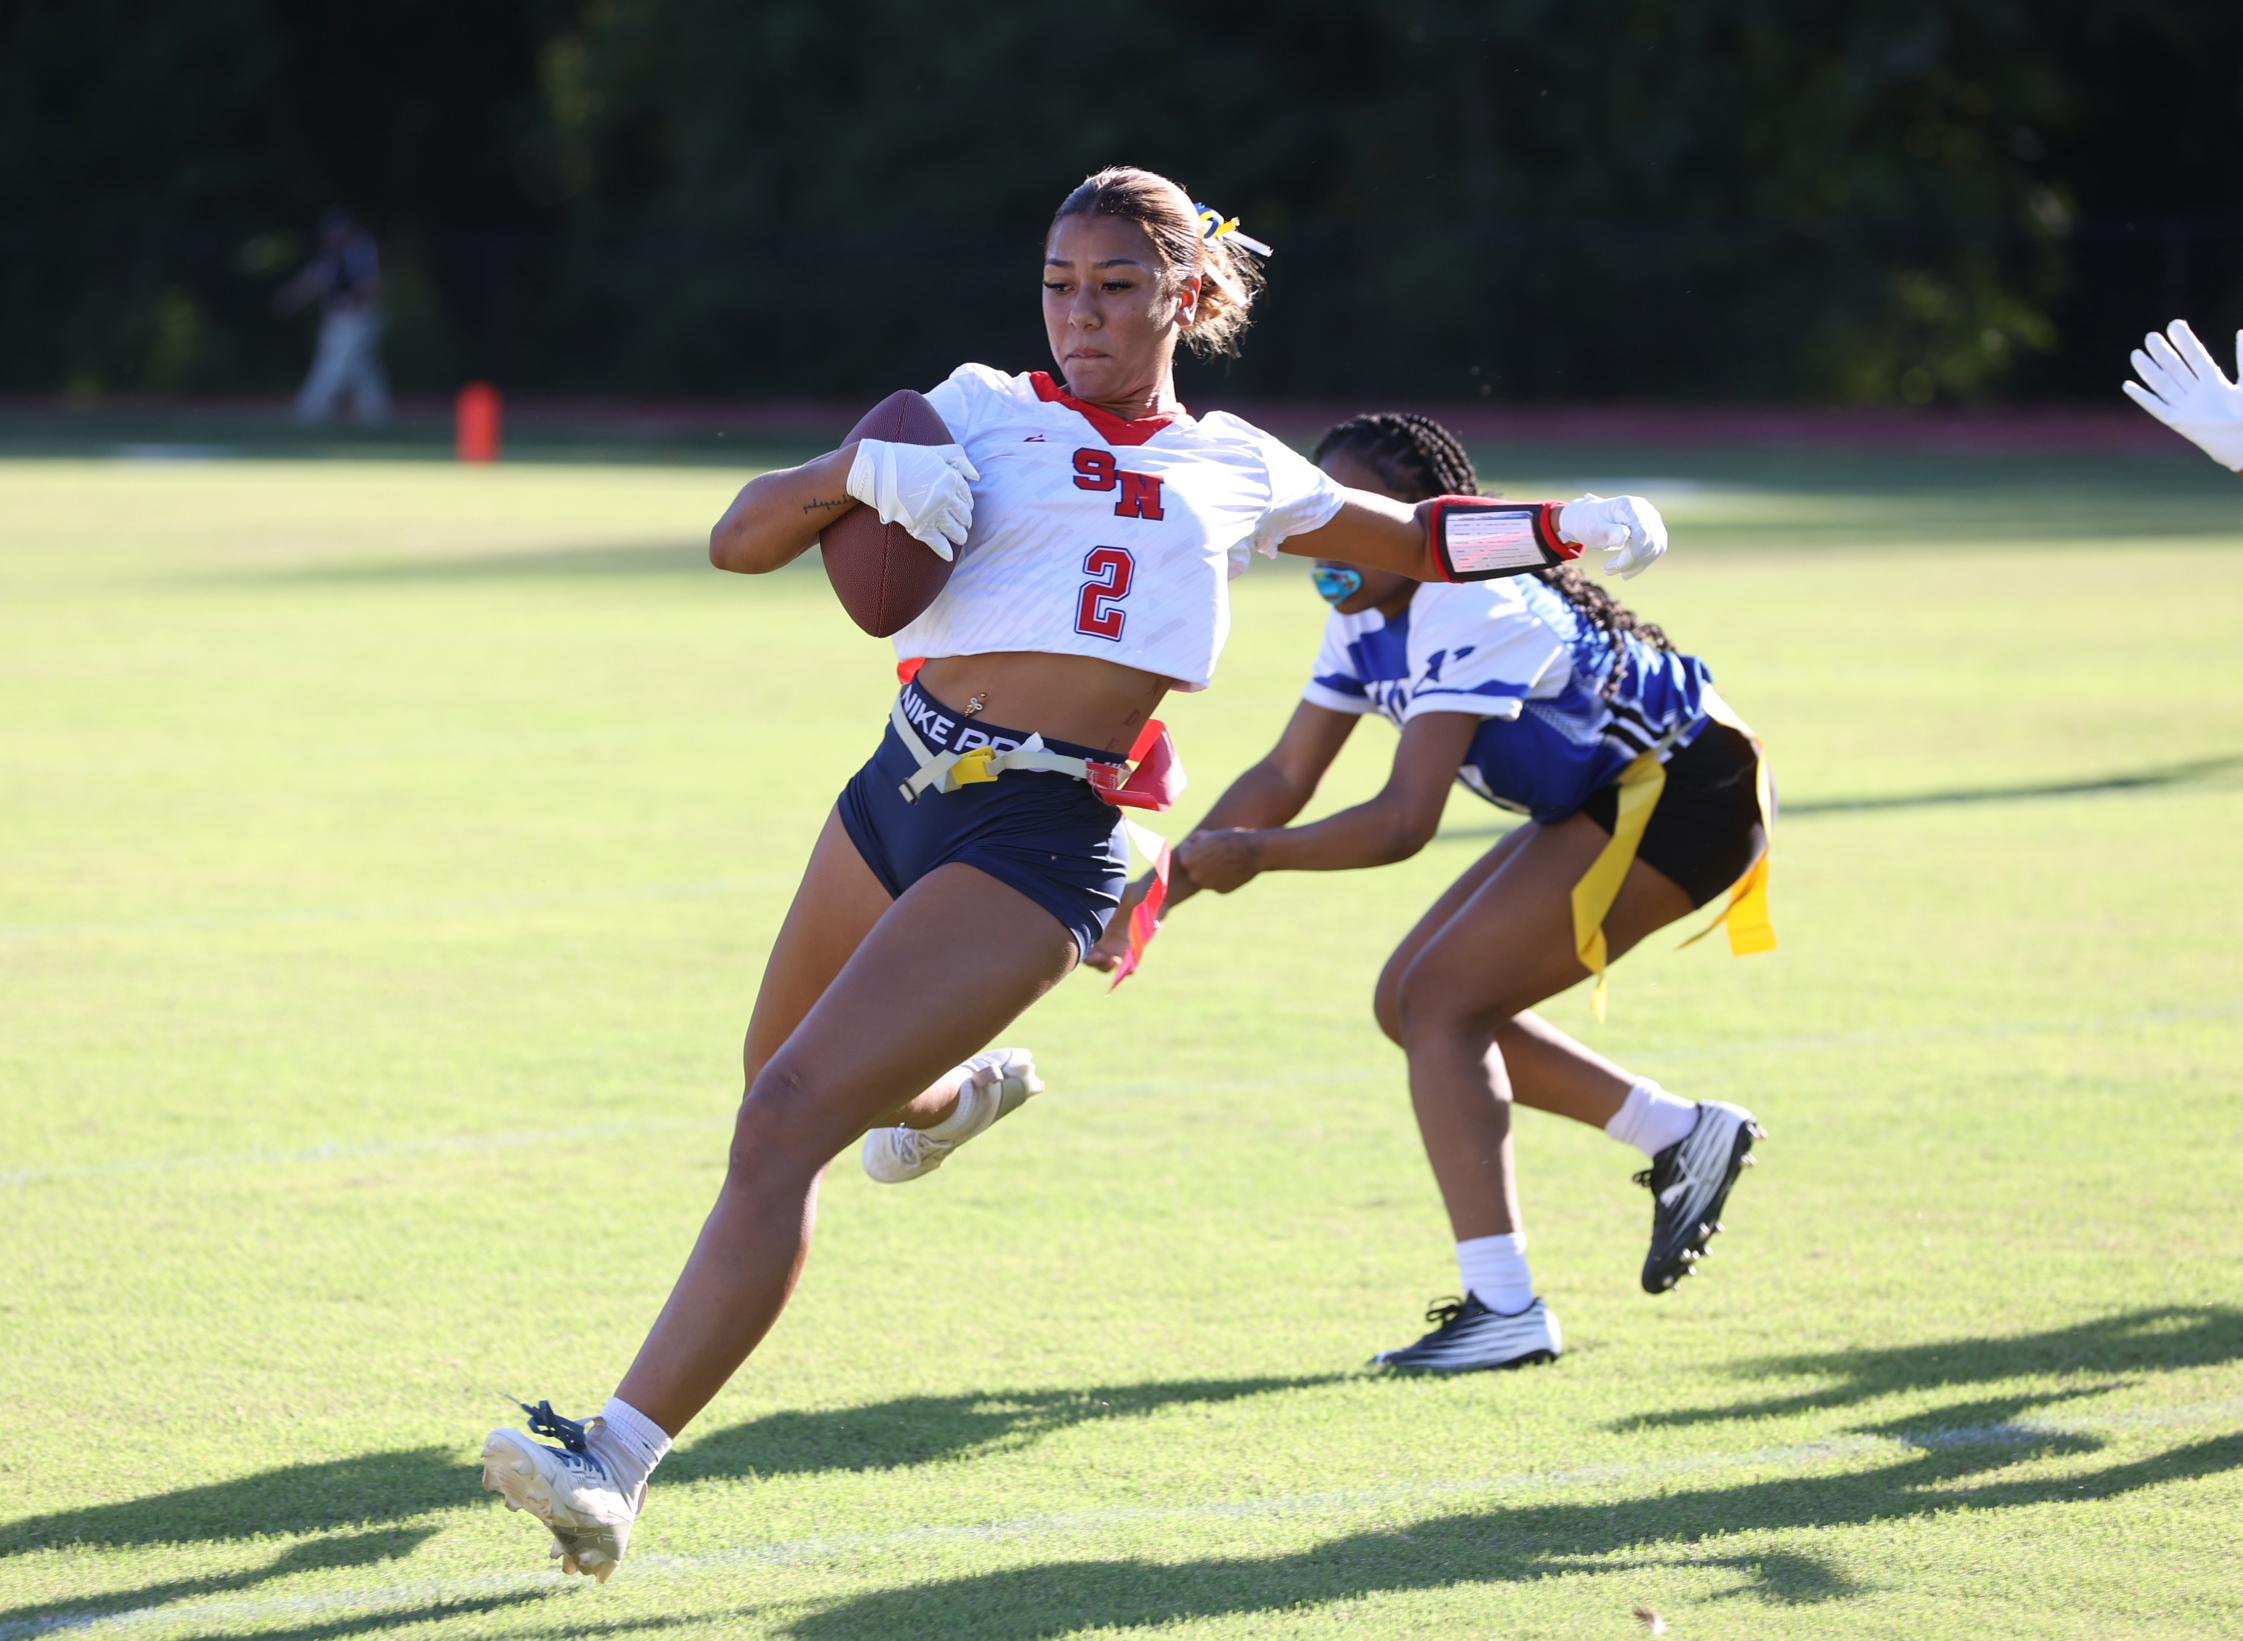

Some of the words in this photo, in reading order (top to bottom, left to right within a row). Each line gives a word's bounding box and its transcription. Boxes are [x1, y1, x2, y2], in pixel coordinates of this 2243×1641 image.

[1072, 447, 1164, 521] SN
[1074, 545, 1135, 642] 2
[901, 684, 955, 745] NIKE
